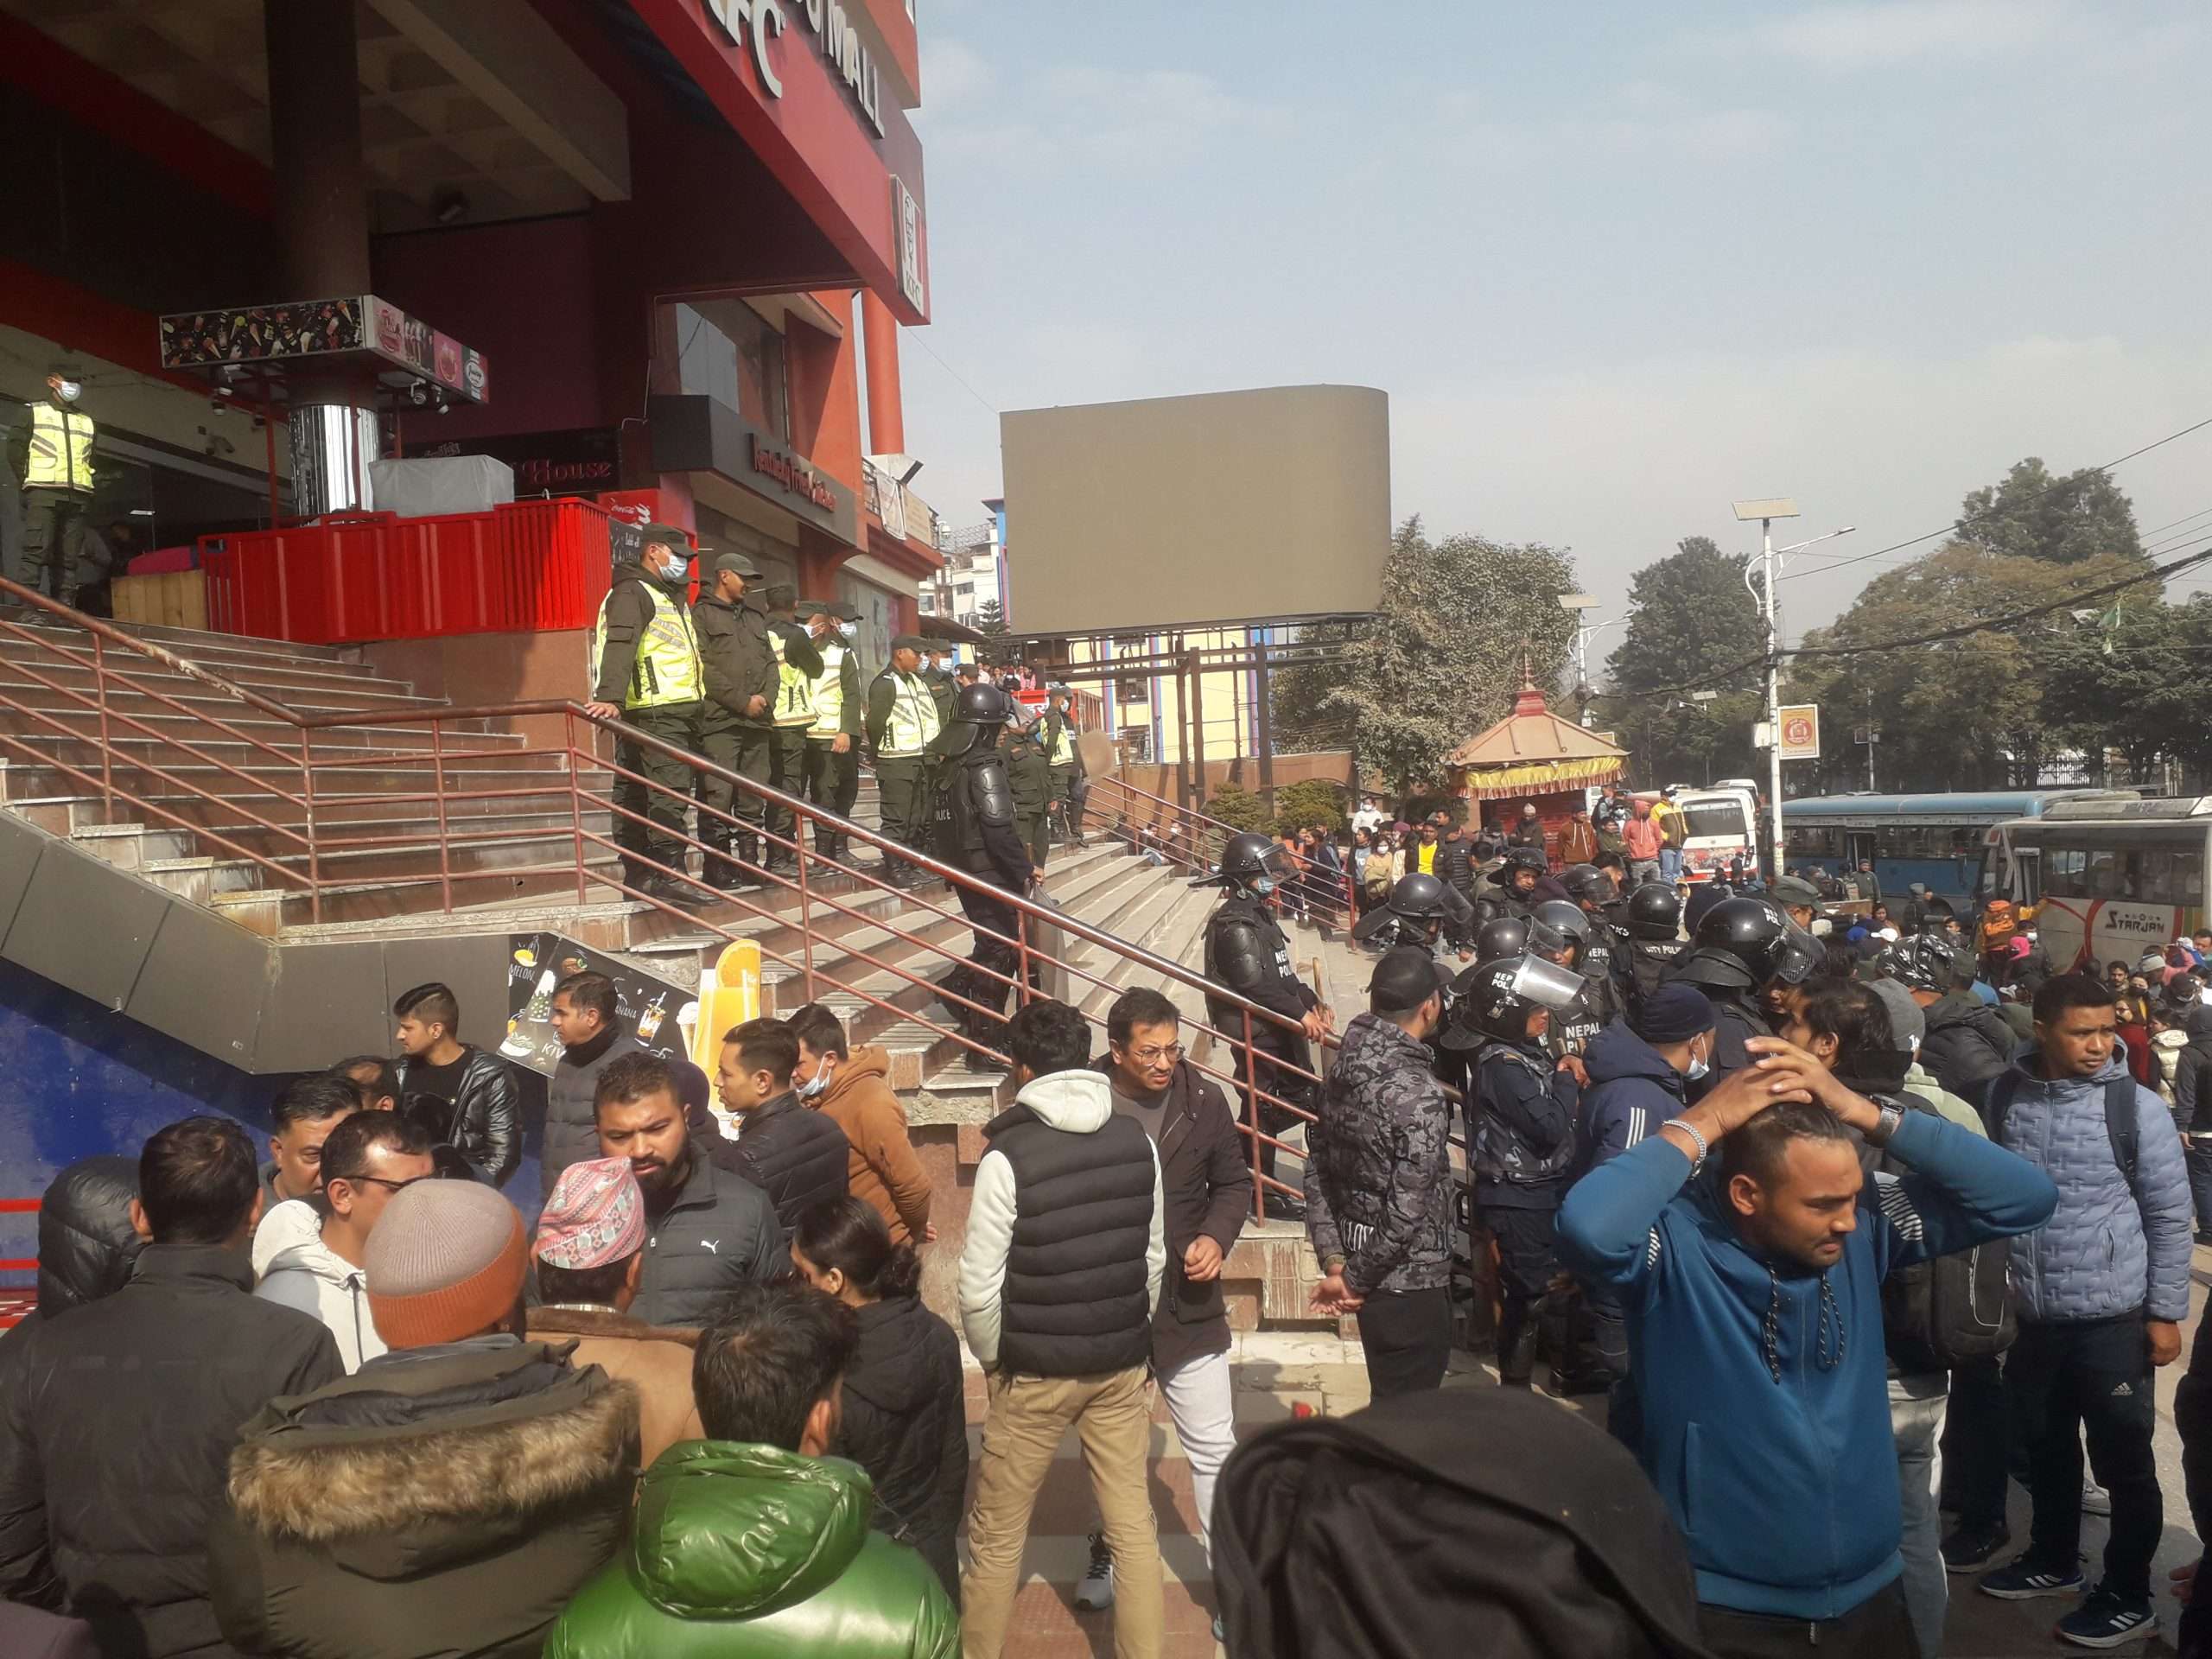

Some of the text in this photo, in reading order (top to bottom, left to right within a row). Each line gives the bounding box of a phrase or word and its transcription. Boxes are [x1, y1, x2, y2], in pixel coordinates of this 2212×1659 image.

[521, 457, 612, 486] House
[509, 963, 535, 982] MELON
[1493, 971, 1513, 982] NEP
[1491, 978, 1510, 991] POL
[614, 1003, 638, 1020] ANANA
[1565, 1021, 1602, 1039] NEPAL
